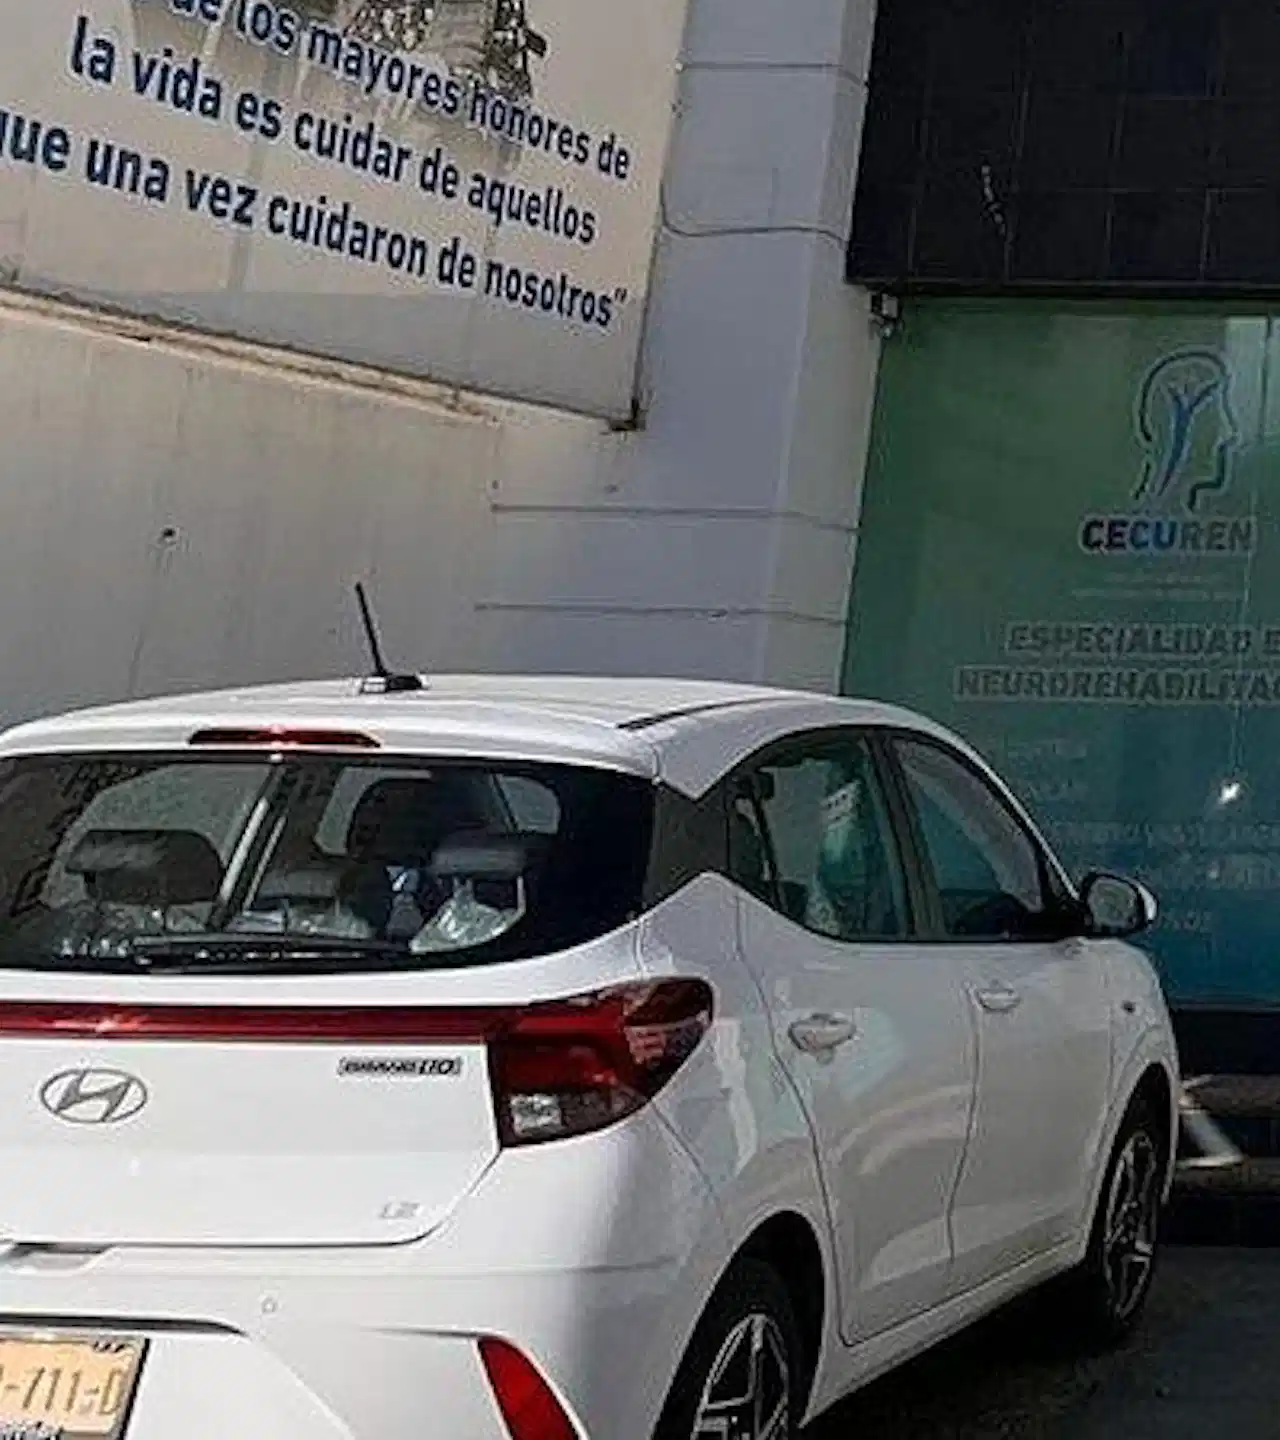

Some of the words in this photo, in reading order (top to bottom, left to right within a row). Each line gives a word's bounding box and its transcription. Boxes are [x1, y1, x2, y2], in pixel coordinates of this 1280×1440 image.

[71, 15, 115, 83] la
[132, 47, 221, 119] vida
[236, 92, 283, 138] es
[294, 111, 412, 182] cuidar
[420, 147, 459, 198] de
[468, 171, 597, 244] aquellos
[307, 26, 460, 114] mayores
[469, 79, 590, 163] honores
[597, 132, 630, 179] de
[87, 139, 170, 201] una
[186, 168, 259, 227] vez
[268, 196, 428, 276] cuidaron
[437, 236, 476, 289] de
[1081, 518, 1253, 551] CECUREN
[1007, 624, 1251, 656] ESPECIALIDAD
